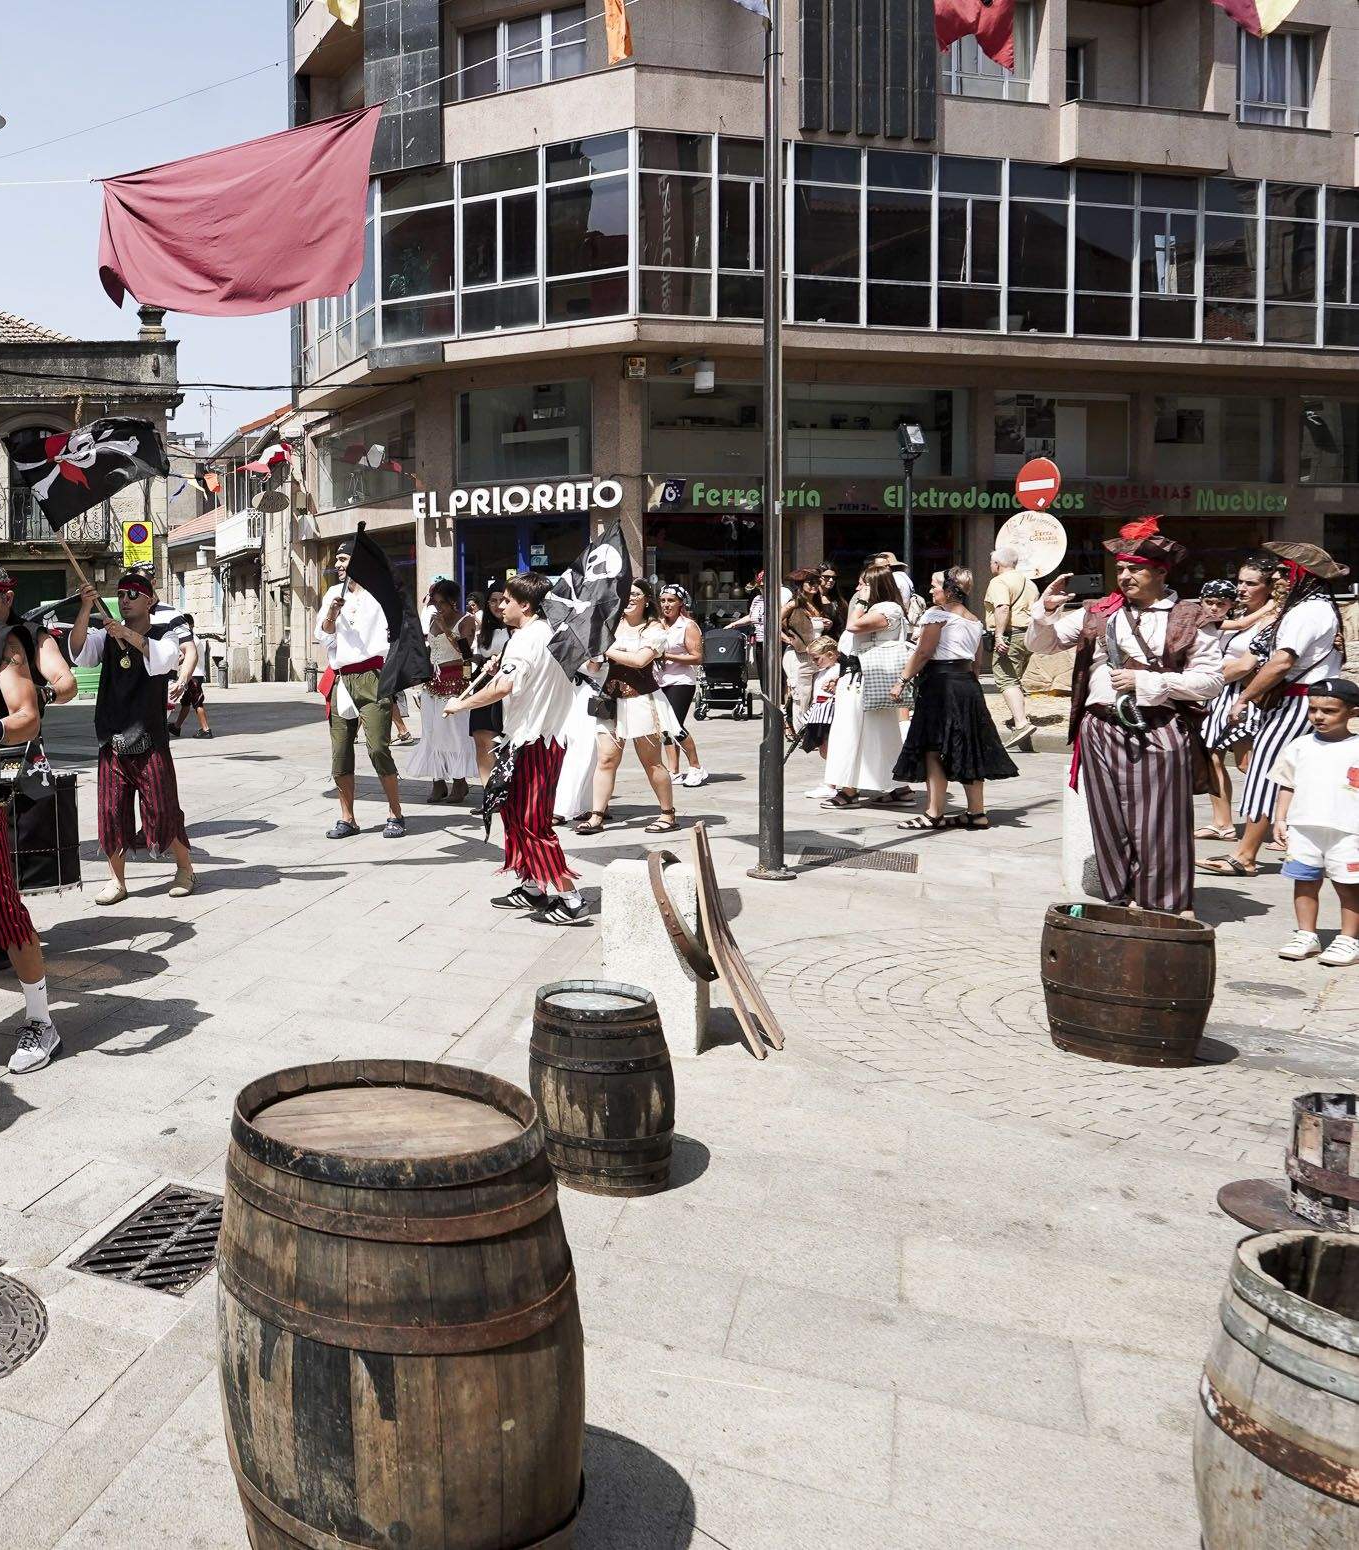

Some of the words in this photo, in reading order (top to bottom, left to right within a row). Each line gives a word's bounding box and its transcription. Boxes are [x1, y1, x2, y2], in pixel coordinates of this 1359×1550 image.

[413, 492, 441, 519] EL
[448, 480, 623, 518] PRIORATO
[1196, 489, 1287, 512] Muebles
